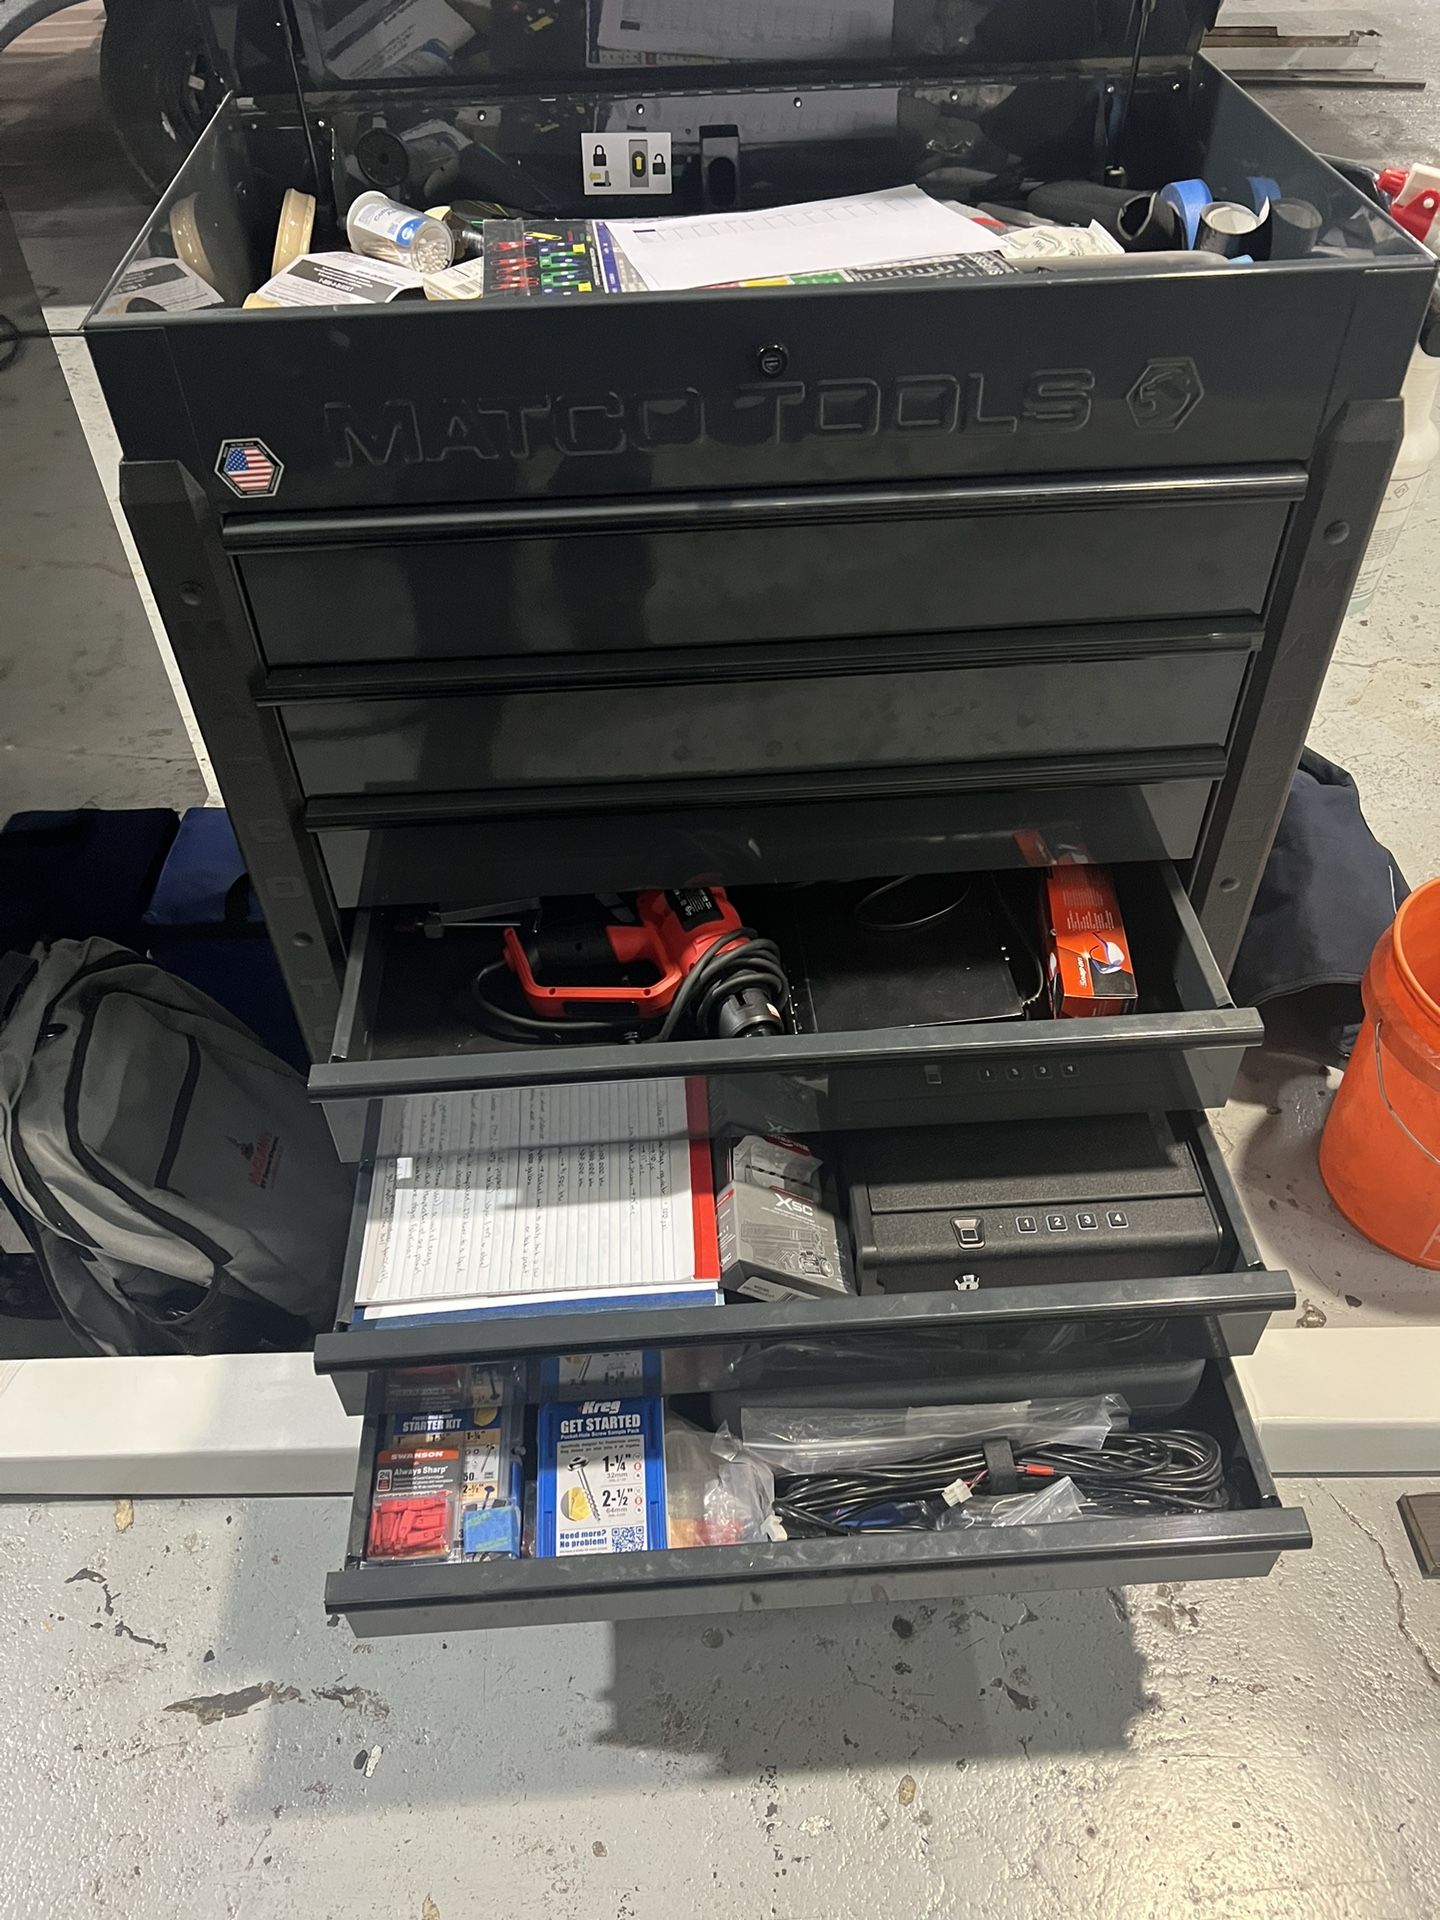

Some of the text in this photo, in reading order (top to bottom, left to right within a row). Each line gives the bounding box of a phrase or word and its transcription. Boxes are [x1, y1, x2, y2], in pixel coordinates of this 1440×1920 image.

[323, 368, 1095, 467] MATCO TOOLS
[774, 1192, 814, 1217] XSC
[1053, 1217, 1062, 1226] 2
[1083, 1215, 1092, 1225] 3
[1114, 1213, 1122, 1223] 4
[582, 1401, 621, 1415] Kreg
[403, 1418, 462, 1432] STARTER KIT
[560, 1413, 641, 1434] GET STARTED
[607, 1430, 626, 1438] Sample
[391, 1450, 444, 1460] SWANSON
[393, 1467, 422, 1477] Always
[560, 1528, 608, 1540] Need more?
[560, 1536, 608, 1549] No problem!
